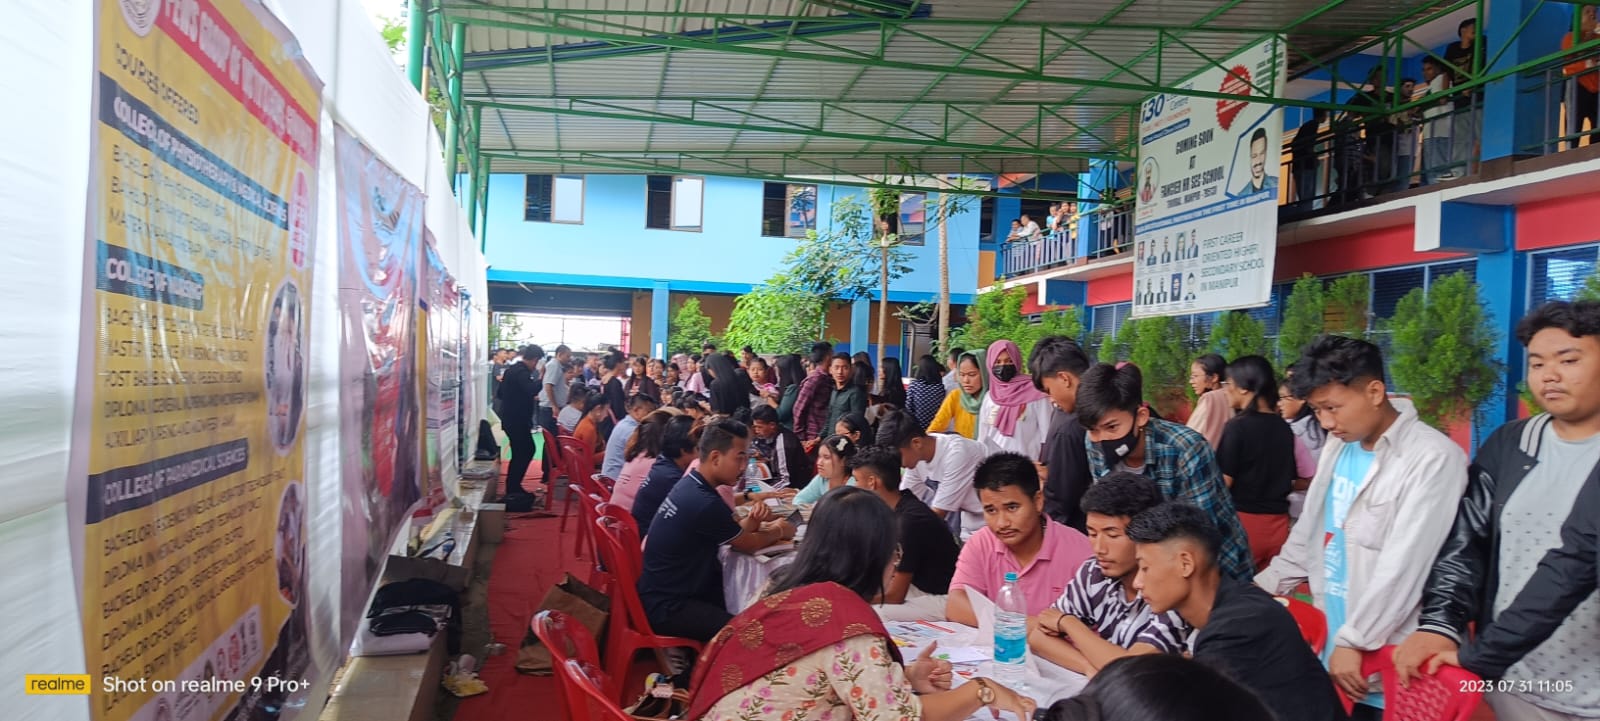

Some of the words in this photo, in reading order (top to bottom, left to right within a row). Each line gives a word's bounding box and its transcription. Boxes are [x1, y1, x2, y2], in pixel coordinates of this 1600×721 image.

[1141, 93, 1166, 124] i30
[1176, 134, 1198, 155] COMING
[1198, 128, 1214, 146] SOON
[1189, 155, 1196, 169] AT
[1202, 165, 1224, 185] SCHOOL
[1202, 236, 1219, 249] FIRST
[1220, 231, 1243, 246] CAREER
[1201, 263, 1238, 278] SECONDARY
[1239, 257, 1265, 272] SCHOOL
[104, 476, 153, 505] COLLEGE
